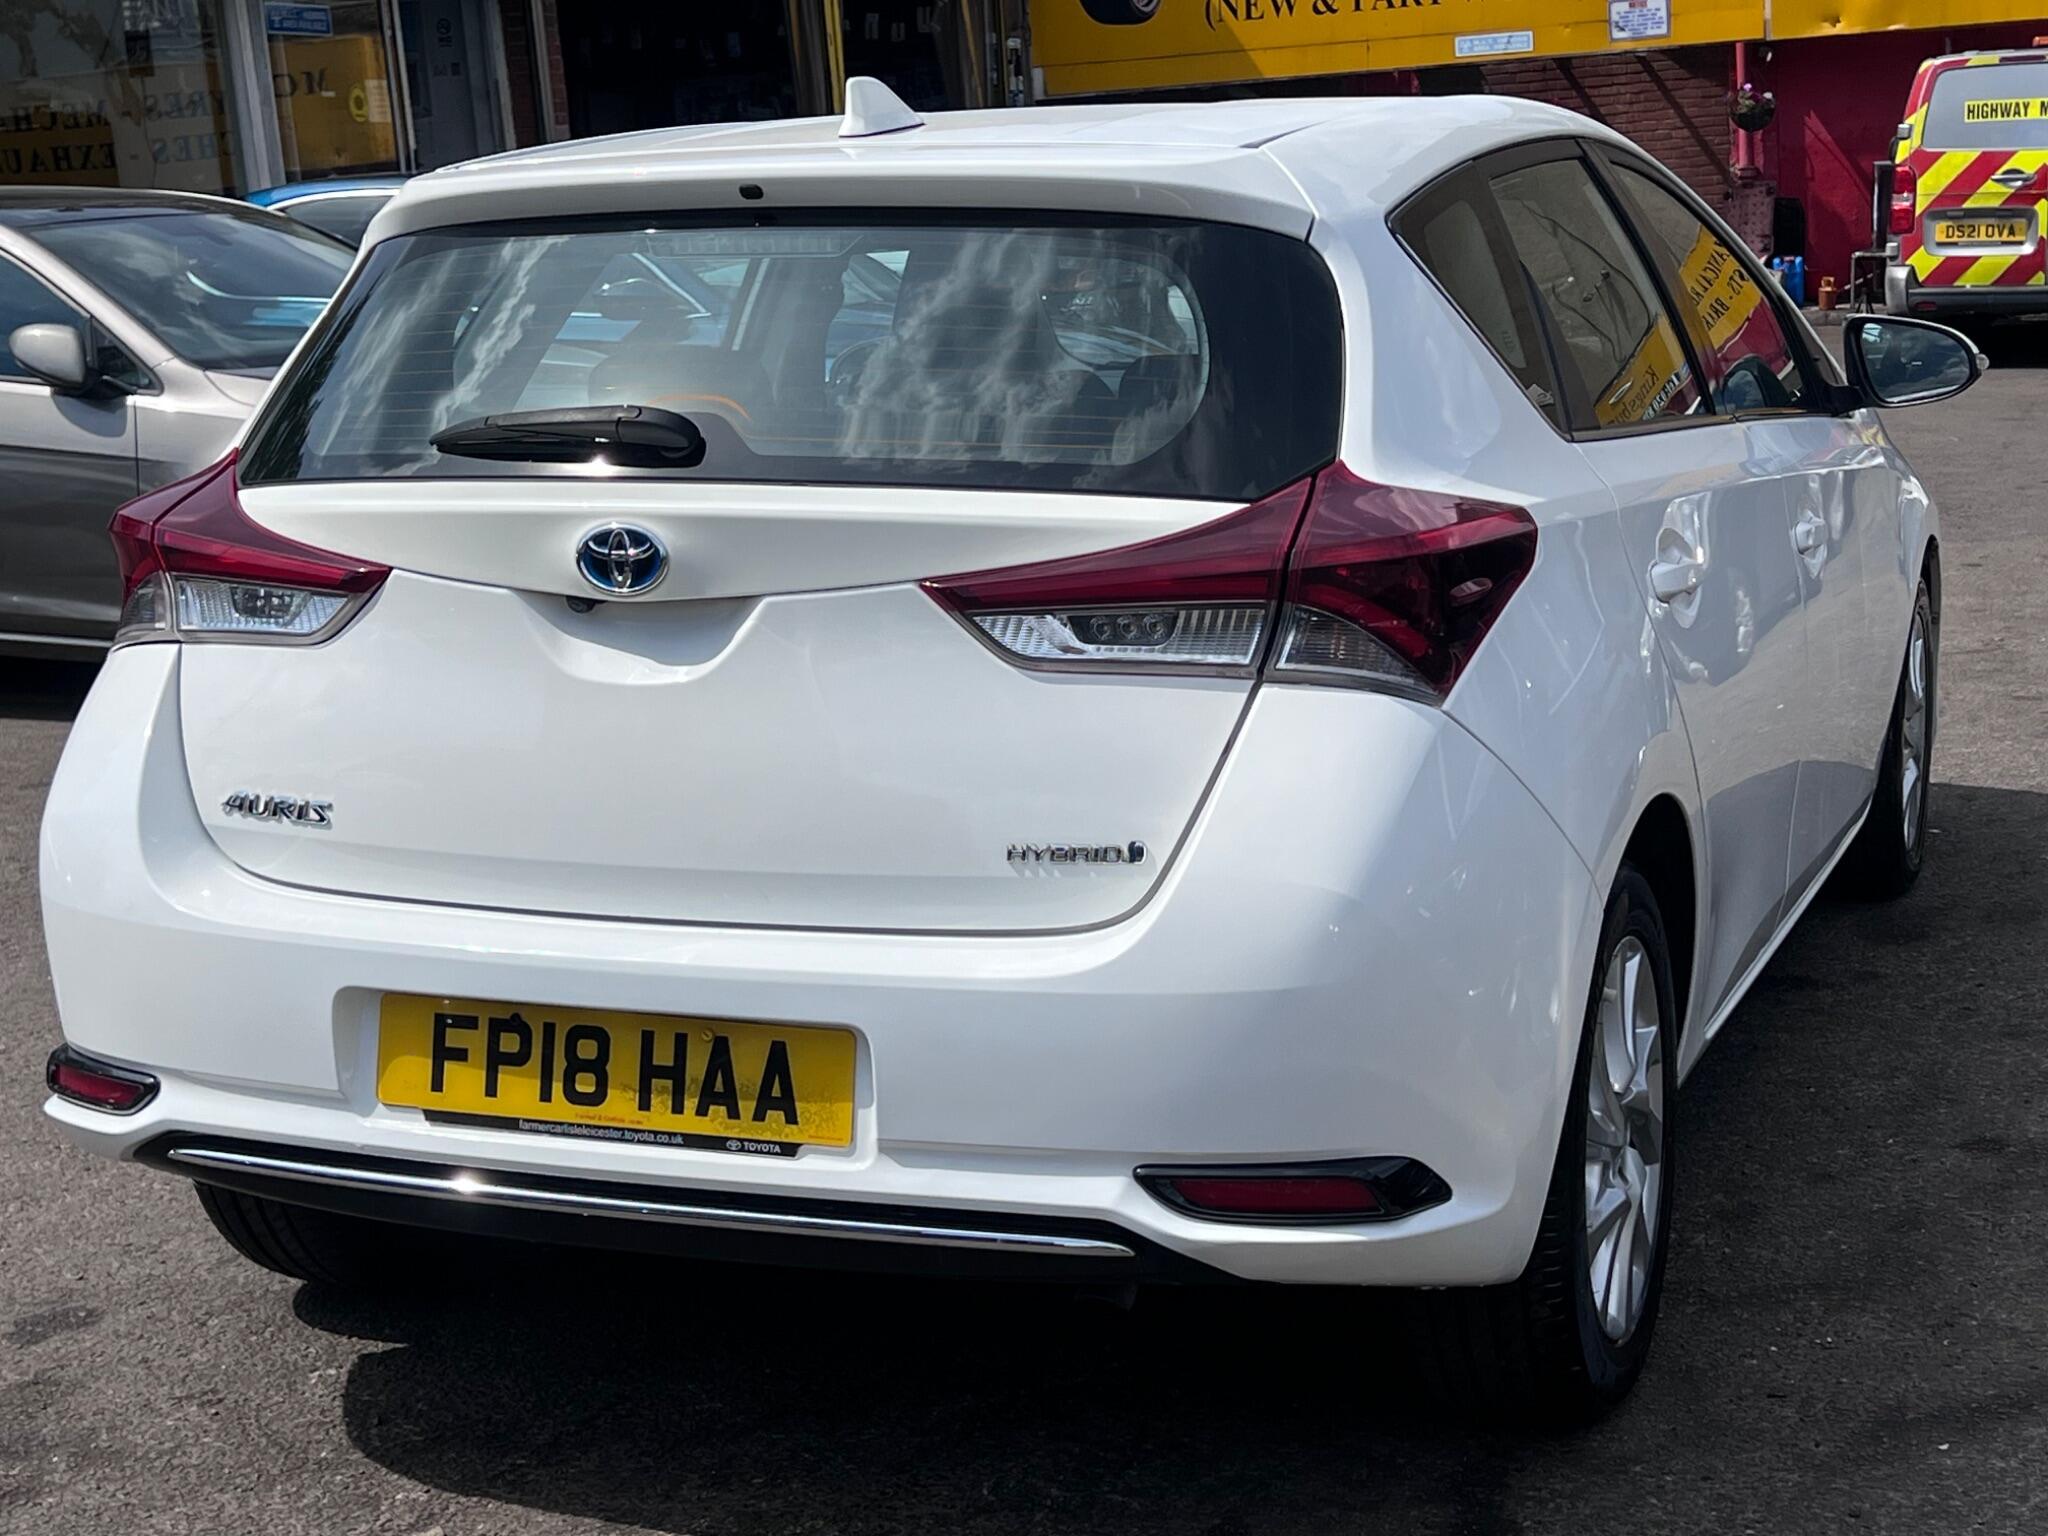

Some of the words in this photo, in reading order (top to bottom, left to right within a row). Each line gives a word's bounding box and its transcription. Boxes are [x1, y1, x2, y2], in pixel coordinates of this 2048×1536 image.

[1966, 101, 2031, 120] HIGHWAY
[1945, 224, 1981, 239] DS21
[1985, 223, 2017, 239] OVA
[221, 793, 334, 827] AURIS
[1006, 842, 1123, 864] HYBRID
[430, 1012, 612, 1109] FP18
[636, 1028, 800, 1126] HAA
[743, 1141, 782, 1154] TOYOTA
